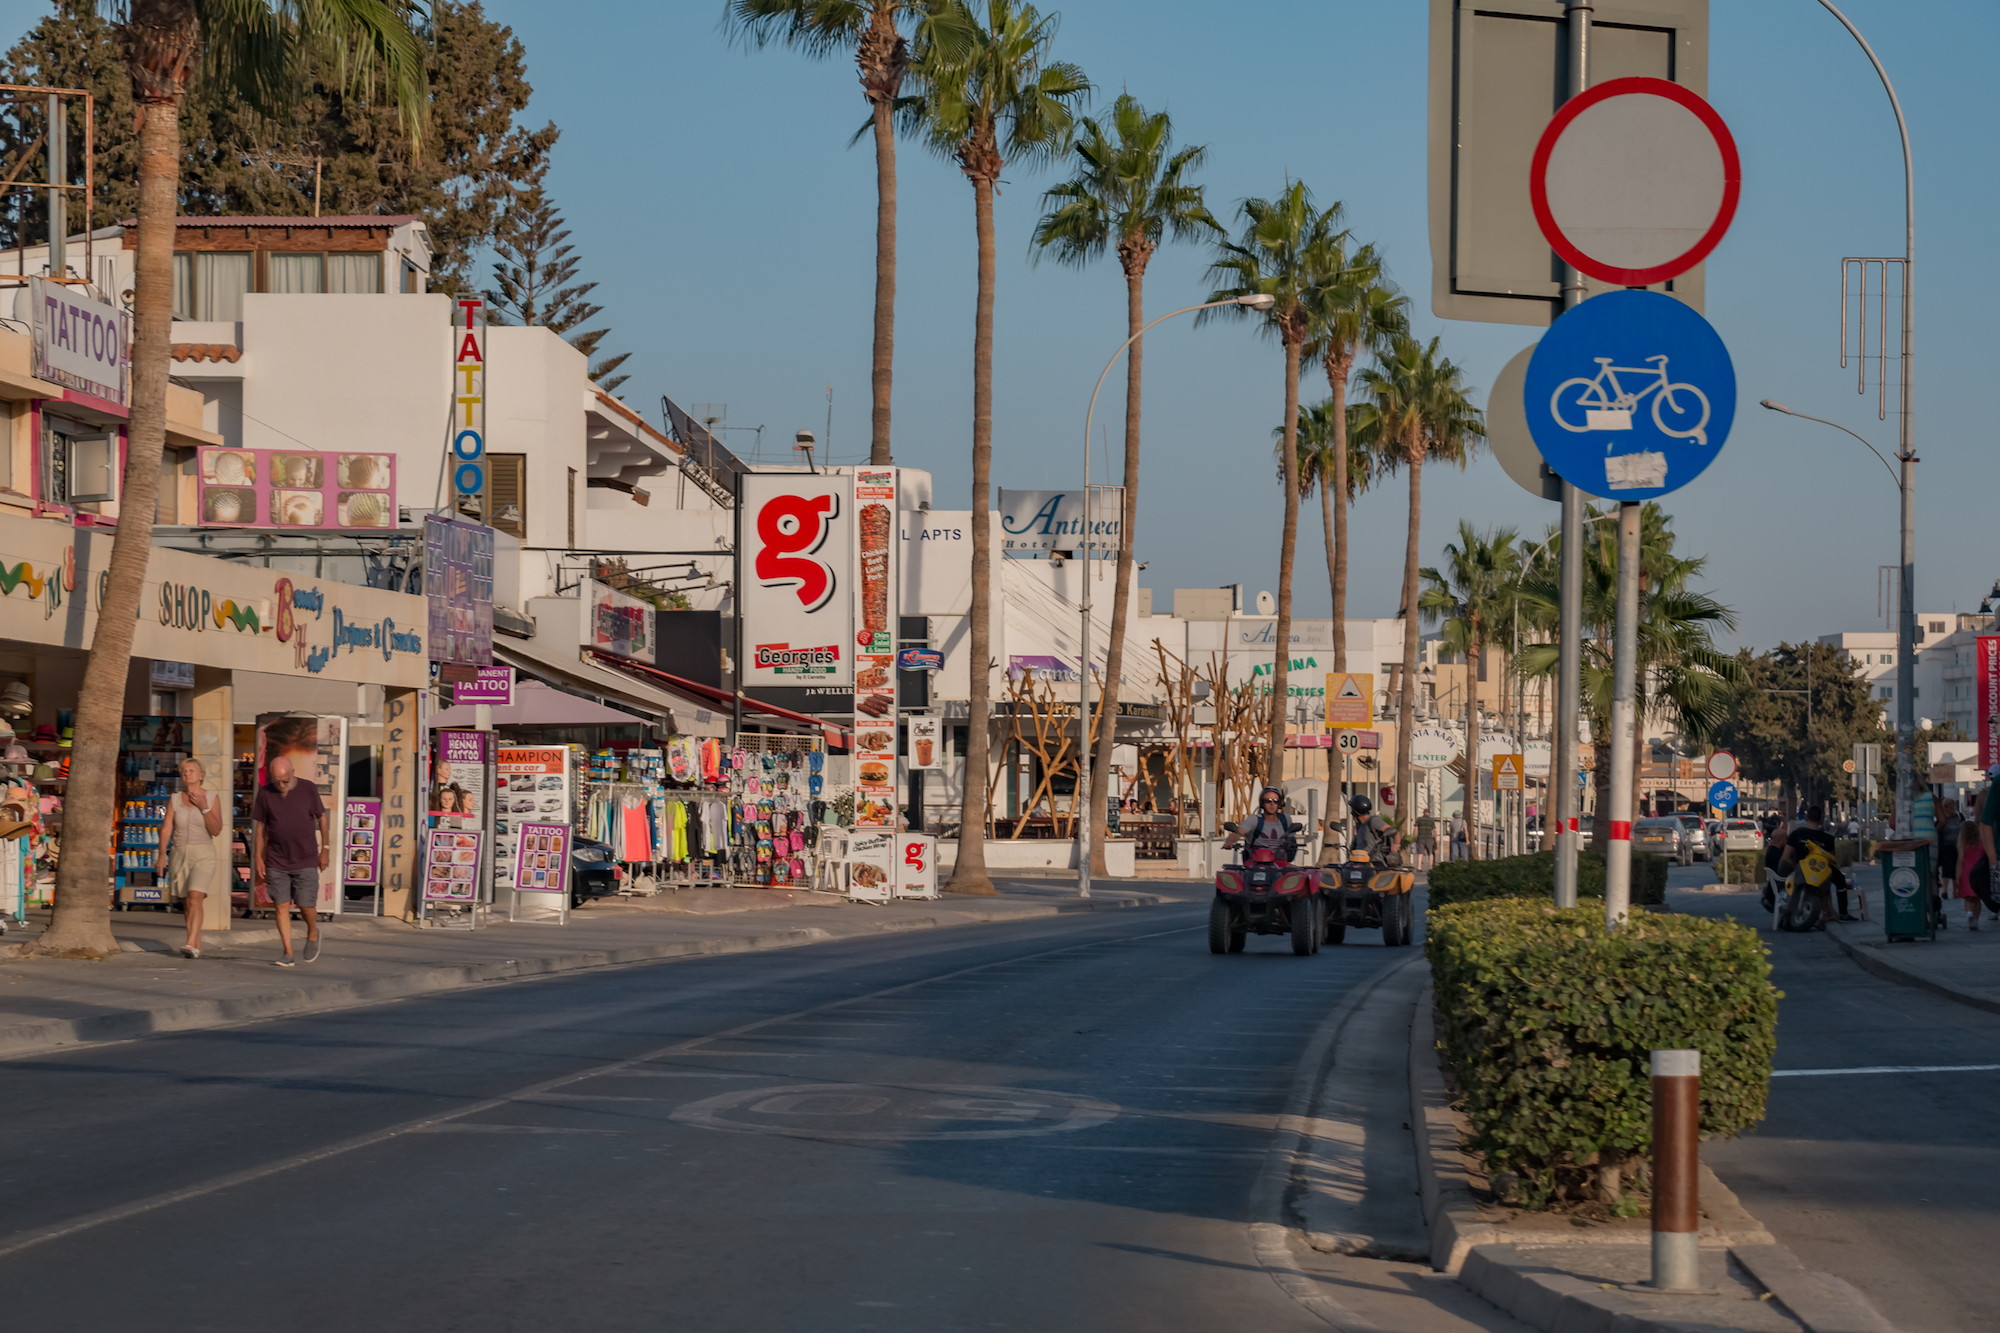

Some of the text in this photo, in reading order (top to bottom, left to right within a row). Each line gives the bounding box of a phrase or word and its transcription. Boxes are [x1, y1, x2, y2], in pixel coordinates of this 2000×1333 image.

[46, 295, 118, 368] TATTOO
[455, 300, 484, 495] TATTOO
[1001, 493, 1120, 535] Anthea
[920, 528, 961, 541] APTS
[1006, 540, 1057, 549] Hotel
[861, 548, 888, 559] Chicken
[866, 556, 883, 566] Beef
[865, 565, 885, 574] Lamb
[867, 573, 884, 581] Pork
[159, 581, 210, 632] SHOP
[1242, 623, 1300, 643] Anea
[760, 648, 834, 668] Georgie's
[1988, 639, 1998, 671] PRICES
[1253, 657, 1318, 676] ATINA
[459, 680, 508, 691] TATTOO
[1340, 735, 1358, 748] 30
[1434, 729, 1455, 748] NAPA
[448, 739, 478, 750] HENNA
[447, 750, 479, 760] TATTOO
[498, 751, 562, 762] HAMPION
[1412, 753, 1447, 762] CENTER
[347, 803, 366, 814] AIR
[527, 825, 564, 836] TATTOO
